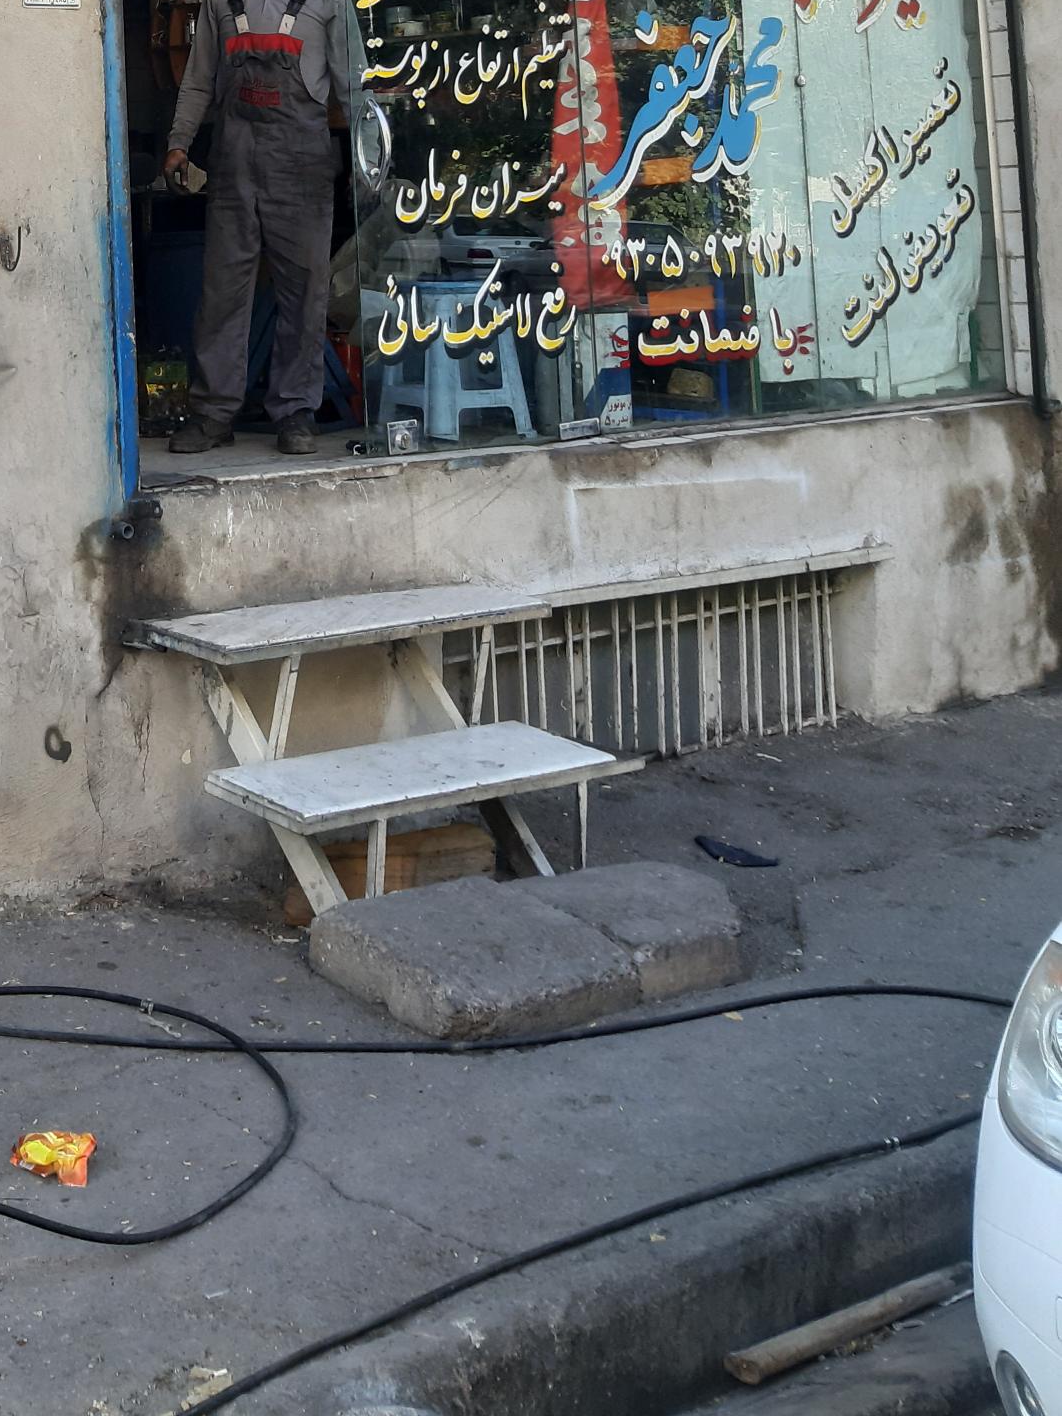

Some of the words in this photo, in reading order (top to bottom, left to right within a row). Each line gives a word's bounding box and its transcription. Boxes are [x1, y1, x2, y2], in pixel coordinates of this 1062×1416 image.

[360, 37, 427, 108] پوسته
[428, 40, 449, 91] از
[454, 24, 519, 104] ارتفاع
[522, 2, 571, 120] تنظیم
[692, 17, 786, 182] محمد
[588, 10, 736, 210] جعفر
[900, 57, 960, 179] تعمیر
[395, 147, 467, 226] فرمان
[471, 161, 567, 219] میزان
[831, 126, 899, 238] اکسل
[602, 233, 800, 282] ۰۹۳۰۵۰۹۳۹۲۰
[901, 168, 974, 293] تعویض
[443, 258, 531, 365] لاستیک
[536, 262, 577, 351] رفع
[637, 304, 761, 361] ضمانت
[769, 307, 798, 370] با
[841, 246, 900, 348] لنت
